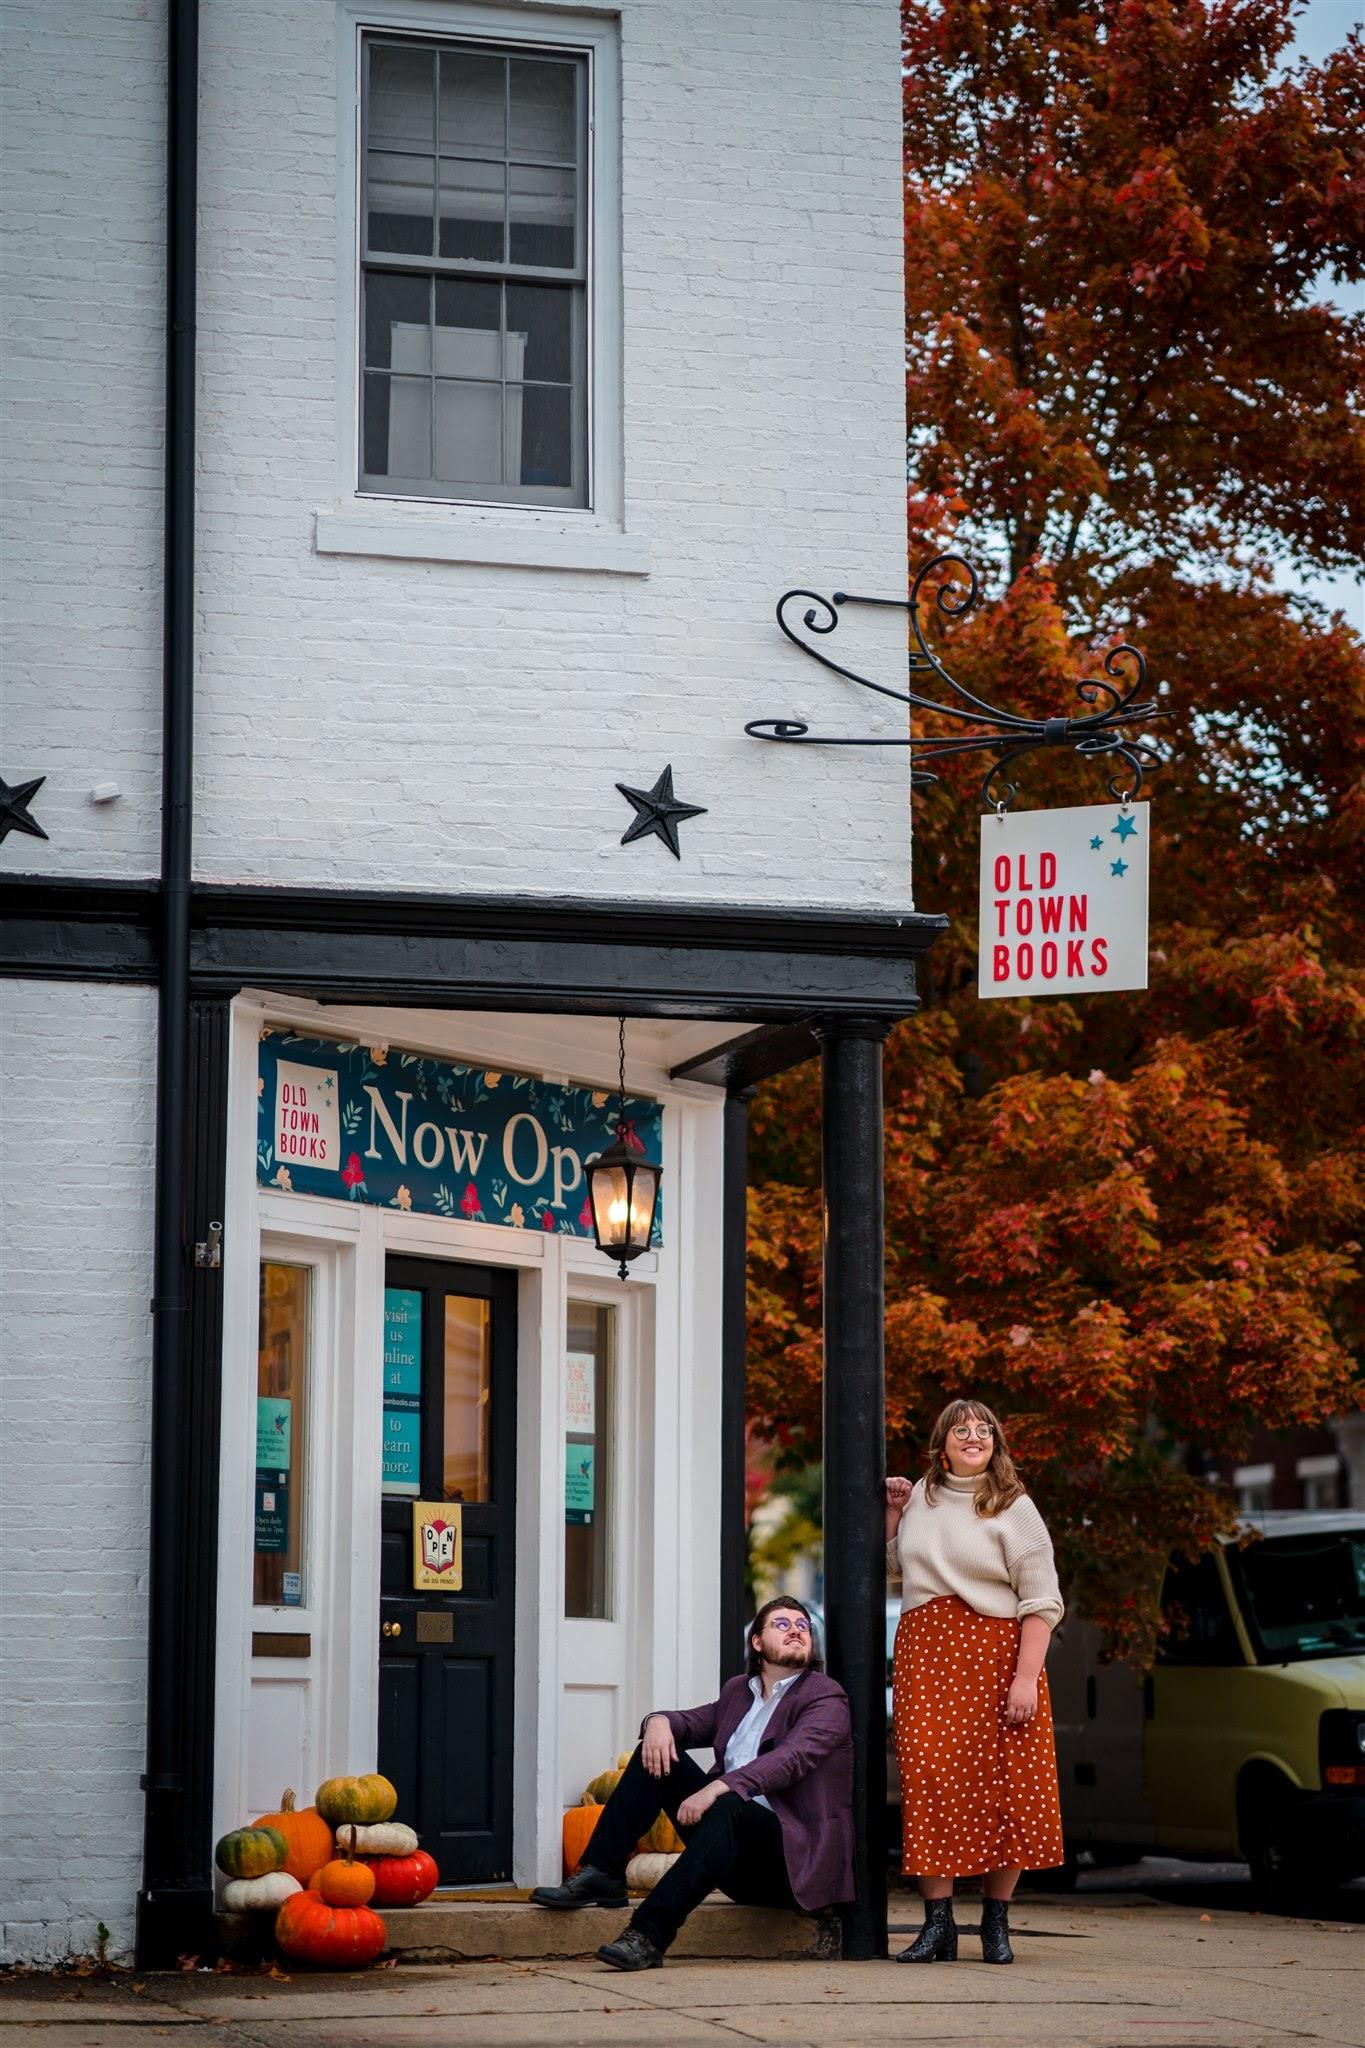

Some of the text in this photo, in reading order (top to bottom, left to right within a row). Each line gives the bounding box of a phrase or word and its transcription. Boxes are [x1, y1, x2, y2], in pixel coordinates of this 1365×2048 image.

[994, 852, 1056, 893] OLD
[994, 894, 1087, 937] TOWN
[993, 938, 1108, 982] BOOKS
[282, 1083, 307, 1107] OLD
[282, 1108, 319, 1134] TOWN
[280, 1133, 327, 1160] BOOKS
[363, 1085, 602, 1209] Now Op
[384, 1306, 408, 1324] visit
[390, 1330, 403, 1342] us
[384, 1347, 415, 1365] nline
[390, 1371, 401, 1385] at
[390, 1419, 401, 1432] to
[383, 1440, 411, 1453] earn
[286, 1580, 299, 1588] YOU
